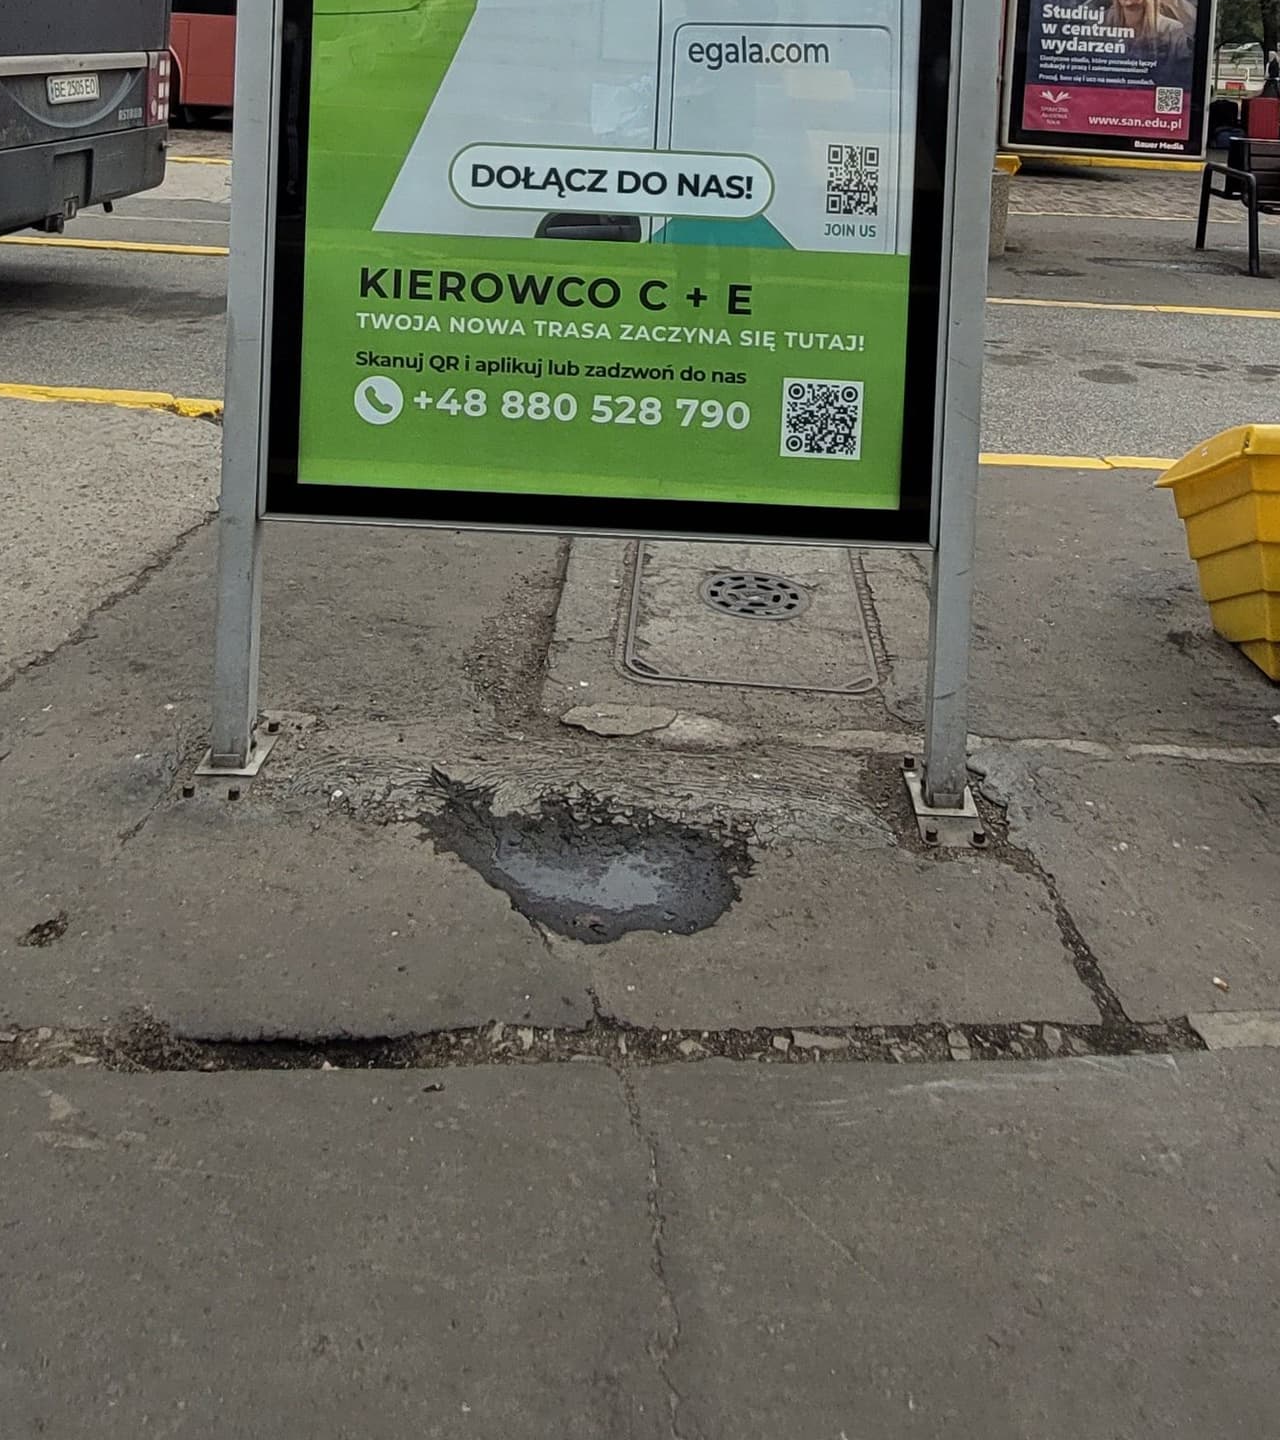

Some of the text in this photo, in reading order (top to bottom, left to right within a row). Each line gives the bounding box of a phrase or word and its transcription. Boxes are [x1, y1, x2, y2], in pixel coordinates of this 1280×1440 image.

[1042, 3, 1105, 25] Studiuj
[1040, 36, 1126, 55] wydarzeń
[1041, 23, 1135, 39] w centrum
[688, 35, 830, 71] egala.com
[1088, 116, 1182, 131] www.san.edu.pl
[471, 163, 753, 199] DOŁĄCZ DO NAS!
[824, 223, 877, 238] JOIN US
[359, 267, 752, 315] KIEROWCO C + E
[356, 312, 865, 352] TWOJA NOWA TRASA ZACZYNA SIĘ TUTAJ!
[355, 351, 747, 384] Skanuj QR i aplikuj lub zadzwoń do nas
[413, 388, 751, 430] +48 880 528 790
